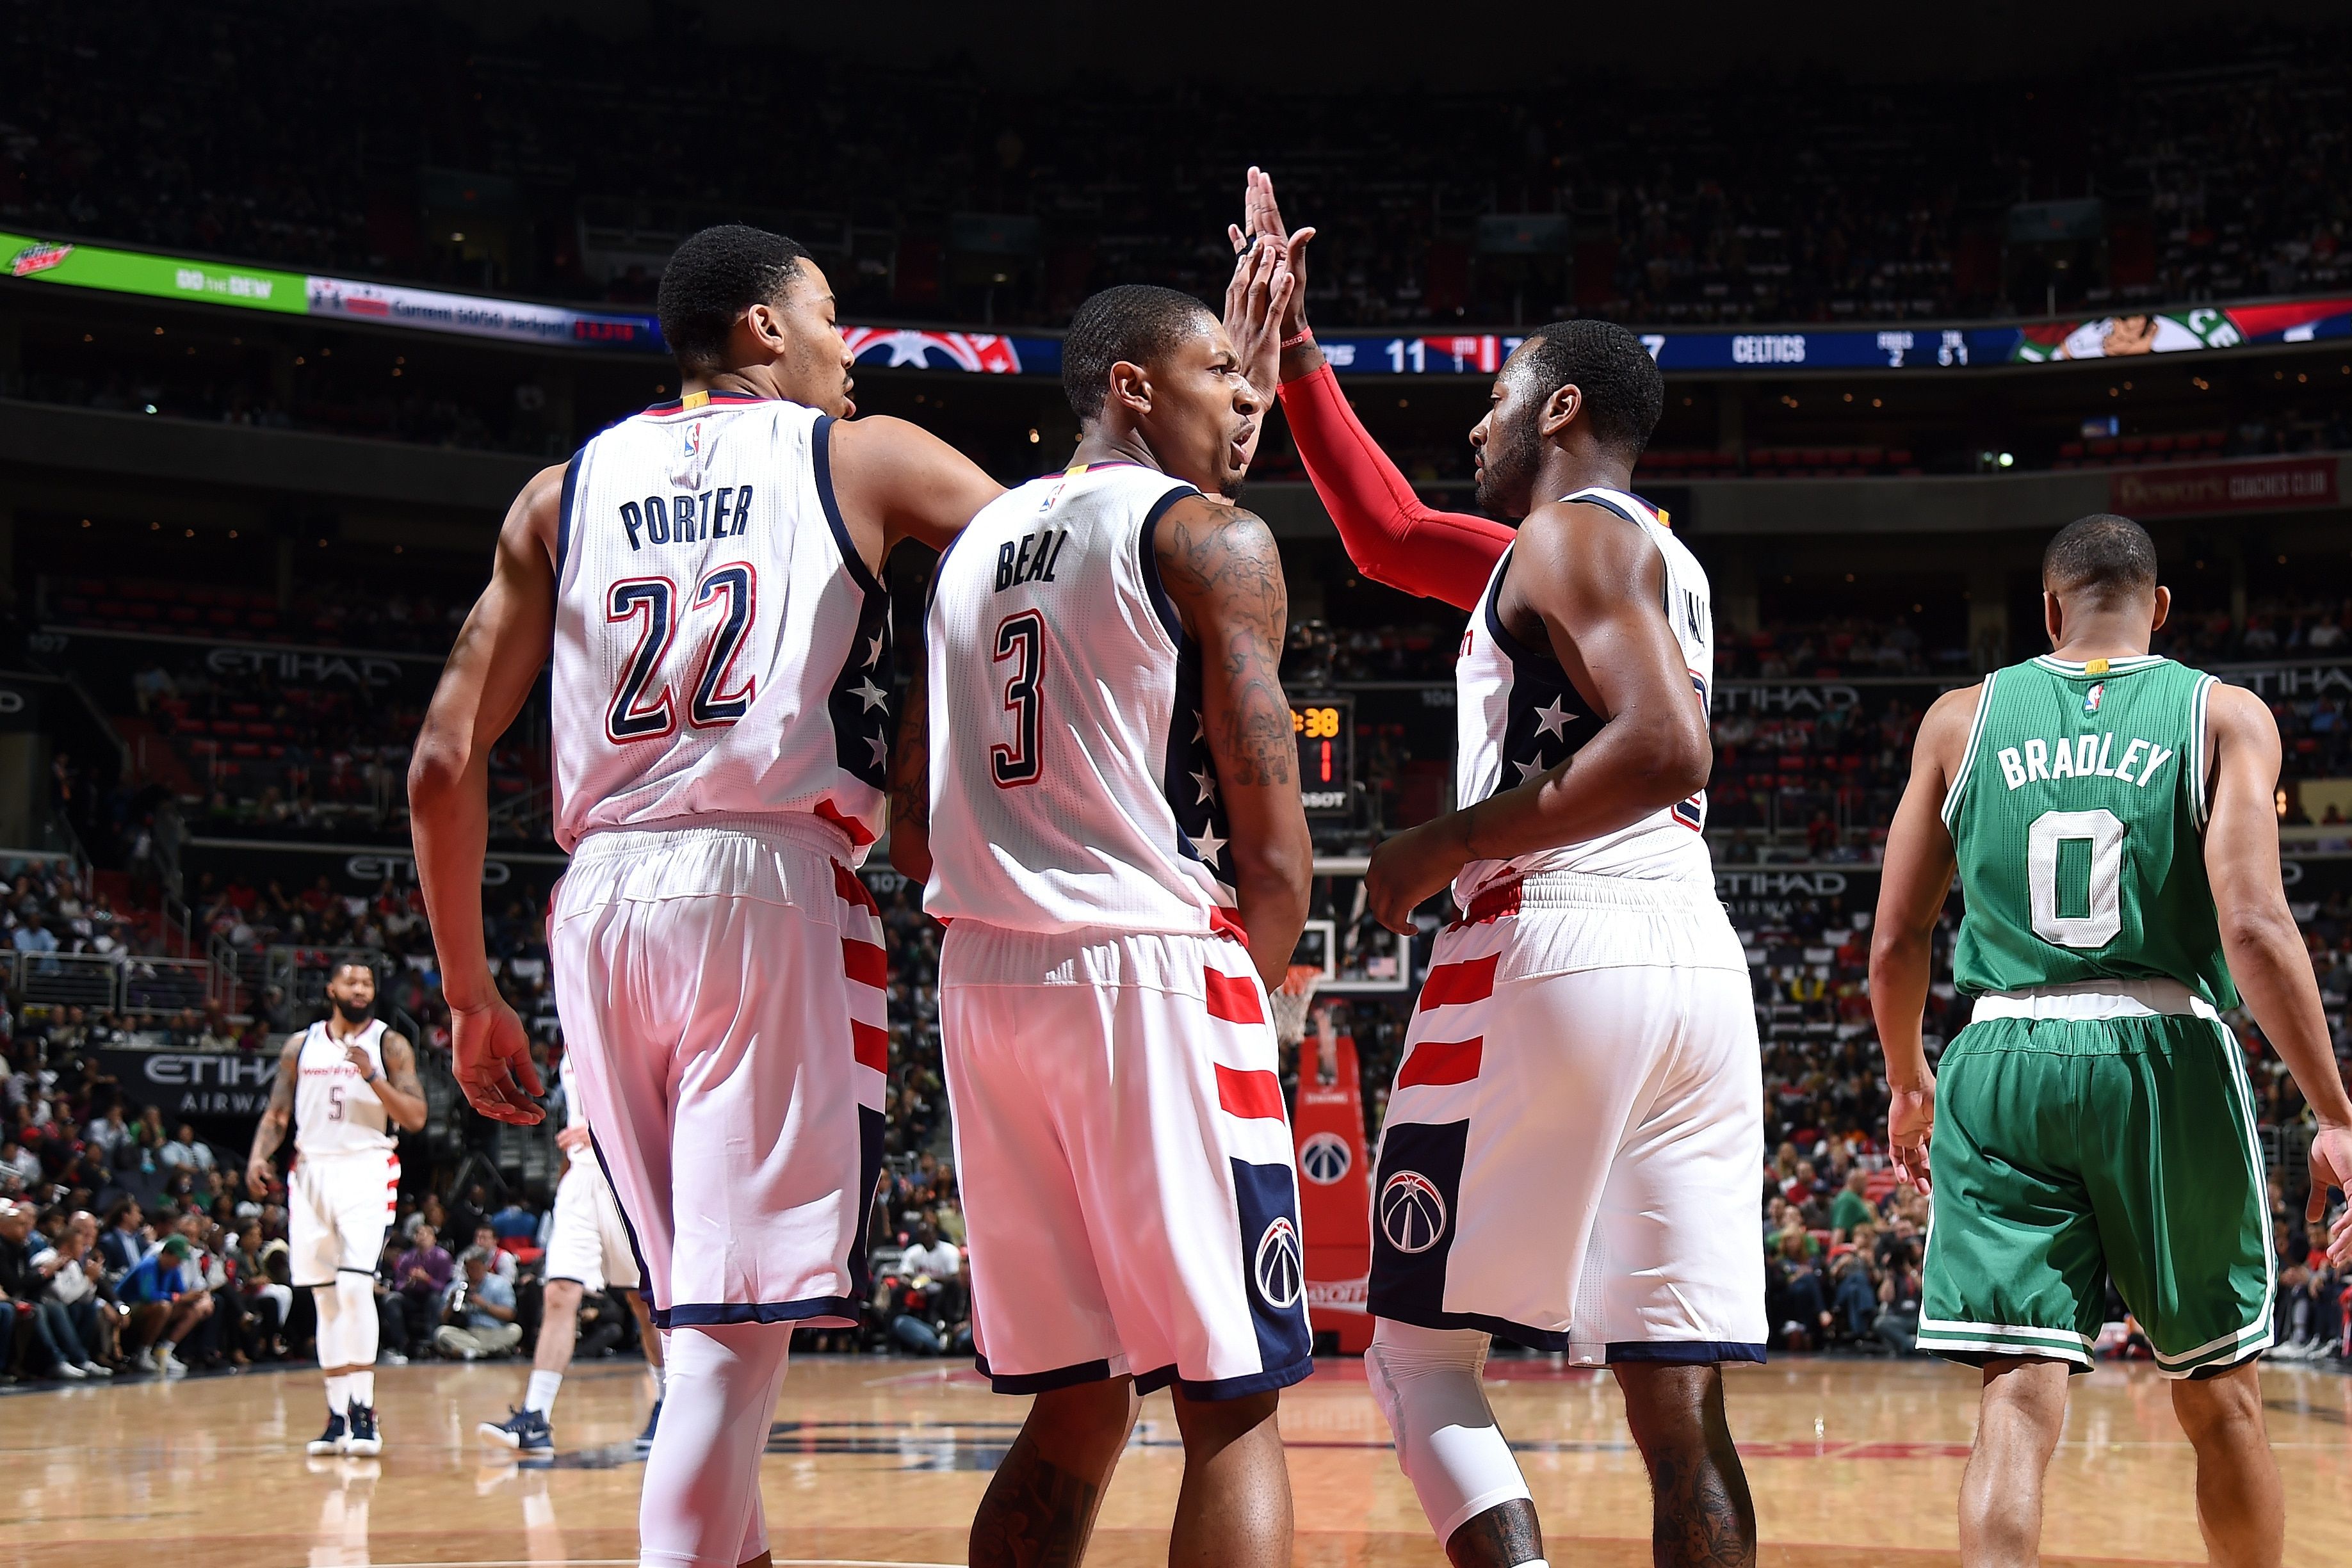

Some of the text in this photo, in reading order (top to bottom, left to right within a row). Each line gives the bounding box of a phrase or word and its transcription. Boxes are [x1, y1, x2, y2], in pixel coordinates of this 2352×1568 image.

[177, 269, 204, 290] DO
[229, 275, 273, 299] DEW
[1281, 336, 1303, 347] ESSED
[1385, 339, 1425, 374] 11
[1732, 334, 1806, 364] CELTICS
[619, 485, 753, 551] PORTER
[994, 529, 1069, 594] BEAL
[206, 647, 403, 687] ETIHAD
[604, 560, 758, 746] 22
[990, 607, 1047, 789] 3
[1997, 732, 2173, 791] BRADLEY
[345, 854, 511, 887] ETID
[2028, 809, 2124, 948] 0
[144, 1055, 282, 1085] ETIH
[304, 1065, 359, 1078] washing
[328, 1085, 345, 1123] 5
